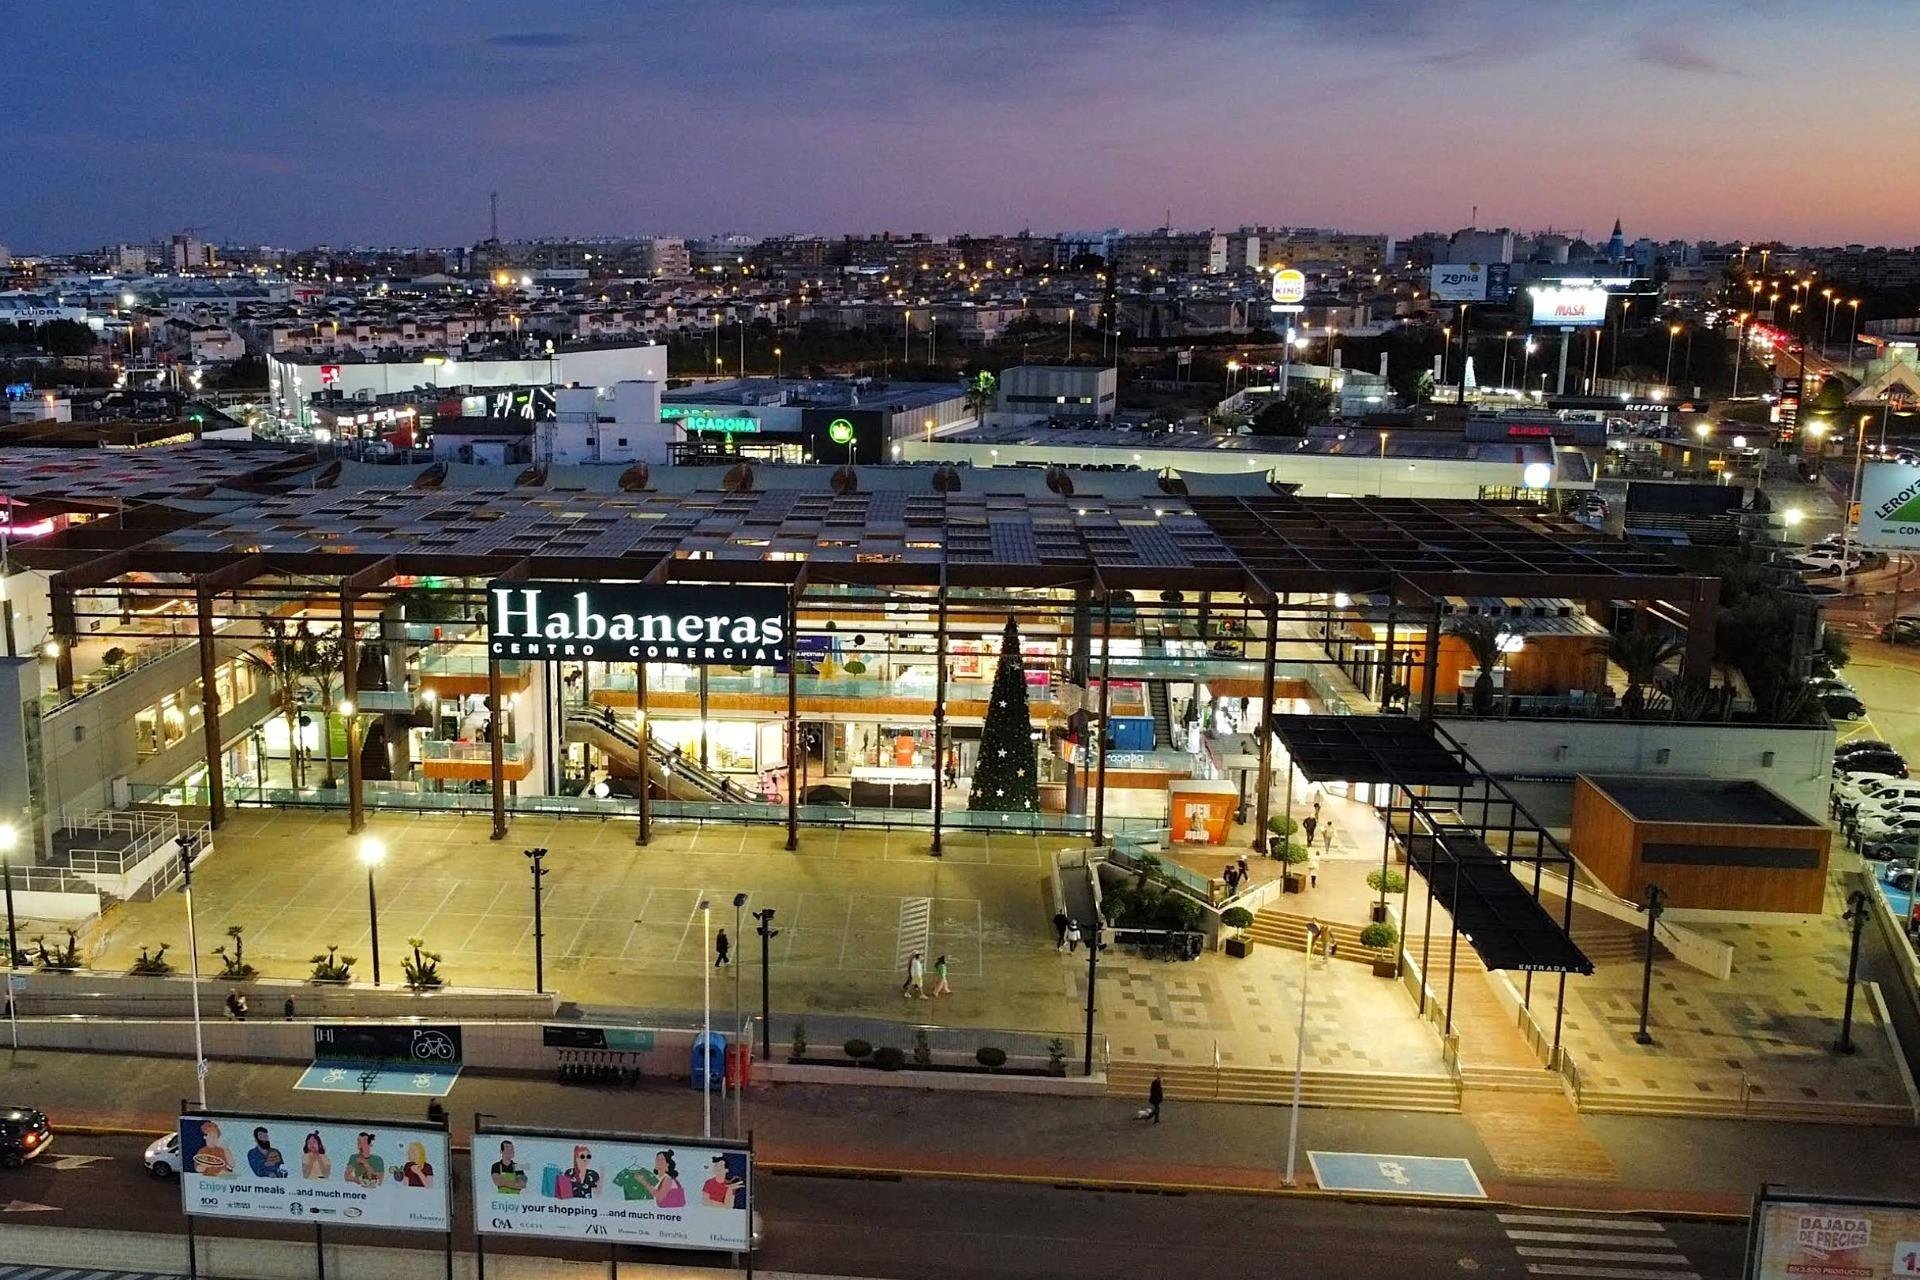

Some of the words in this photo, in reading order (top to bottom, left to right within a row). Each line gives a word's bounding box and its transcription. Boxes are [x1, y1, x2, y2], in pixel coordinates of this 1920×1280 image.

[1275, 287, 1302, 295] KING
[1625, 404, 1669, 412] REPSOL
[687, 417, 756, 431] RCADONA
[1874, 484, 1917, 519] LEROY
[491, 588, 784, 646] Habaneras
[492, 642, 595, 656] CENTRO
[629, 645, 784, 660] COMERCIAL
[1518, 963, 1567, 972] ENTRADA
[413, 1029, 422, 1040] P
[199, 1180, 227, 1192] Enjoy
[229, 1184, 252, 1194] your
[254, 1185, 286, 1195] meals
[315, 1189, 341, 1198] much
[342, 1191, 368, 1200] more
[491, 1200, 519, 1213] Enjoy
[521, 1203, 546, 1214] your
[548, 1204, 598, 1218] shopping
[628, 1210, 655, 1220] much
[656, 1213, 682, 1222] more
[492, 1217, 513, 1229] C&A
[1800, 1217, 1868, 1233] BAJADA
[1799, 1230, 1814, 1243] DE
[1816, 1231, 1869, 1248] PRECIOS
